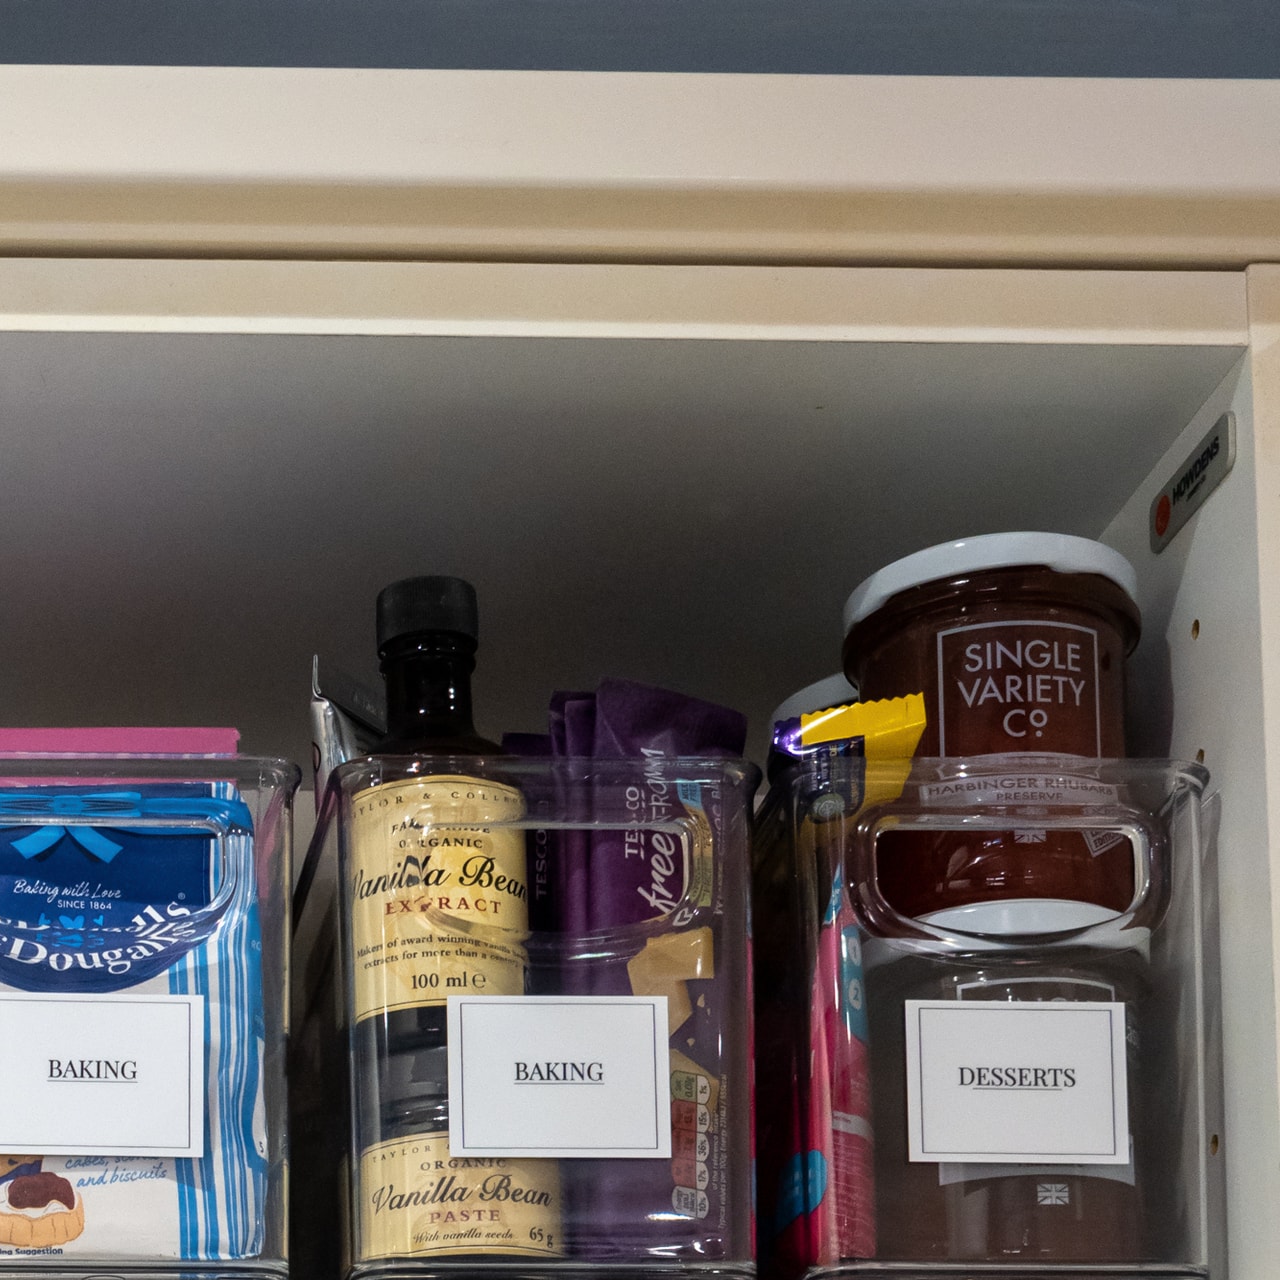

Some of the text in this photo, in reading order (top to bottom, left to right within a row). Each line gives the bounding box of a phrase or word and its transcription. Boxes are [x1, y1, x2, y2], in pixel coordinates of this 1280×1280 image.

[1173, 436, 1219, 506] HOWDENS
[964, 640, 1082, 672] SINGLE
[956, 674, 1086, 708] VARIETY
[422, 792, 431, 800] &
[927, 777, 1114, 797] HARBINGER RHUBARB
[996, 791, 1064, 801] PRESERVE
[458, 855, 527, 902] Bean
[13, 879, 122, 903] Baking with Love
[57, 899, 112, 910] SINCE 1864
[386, 938, 399, 949] of
[401, 934, 433, 946] award
[437, 934, 481, 947] winning
[364, 954, 399, 970] extracts
[402, 950, 418, 961] for
[421, 948, 451, 958] more
[455, 948, 478, 958] than
[411, 973, 439, 990] 100
[446, 971, 467, 988] ml
[48, 1059, 138, 1080] BAKING
[514, 1062, 604, 1082] BAKING
[958, 1066, 1076, 1088] DESSERTS
[698, 1111, 707, 1126] 15%
[373, 1145, 432, 1163] TAYLOR
[698, 1139, 707, 1156] 36%
[420, 1158, 507, 1171] ORGANIC
[76, 1162, 168, 1188] and biscuits
[372, 1174, 553, 1215] Vanilla Bean
[428, 1210, 501, 1224] PASTE
[413, 1228, 513, 1243] With vanilla seeds
[529, 1226, 554, 1248] 65 g
[15, 1246, 63, 1256] Suggestion
